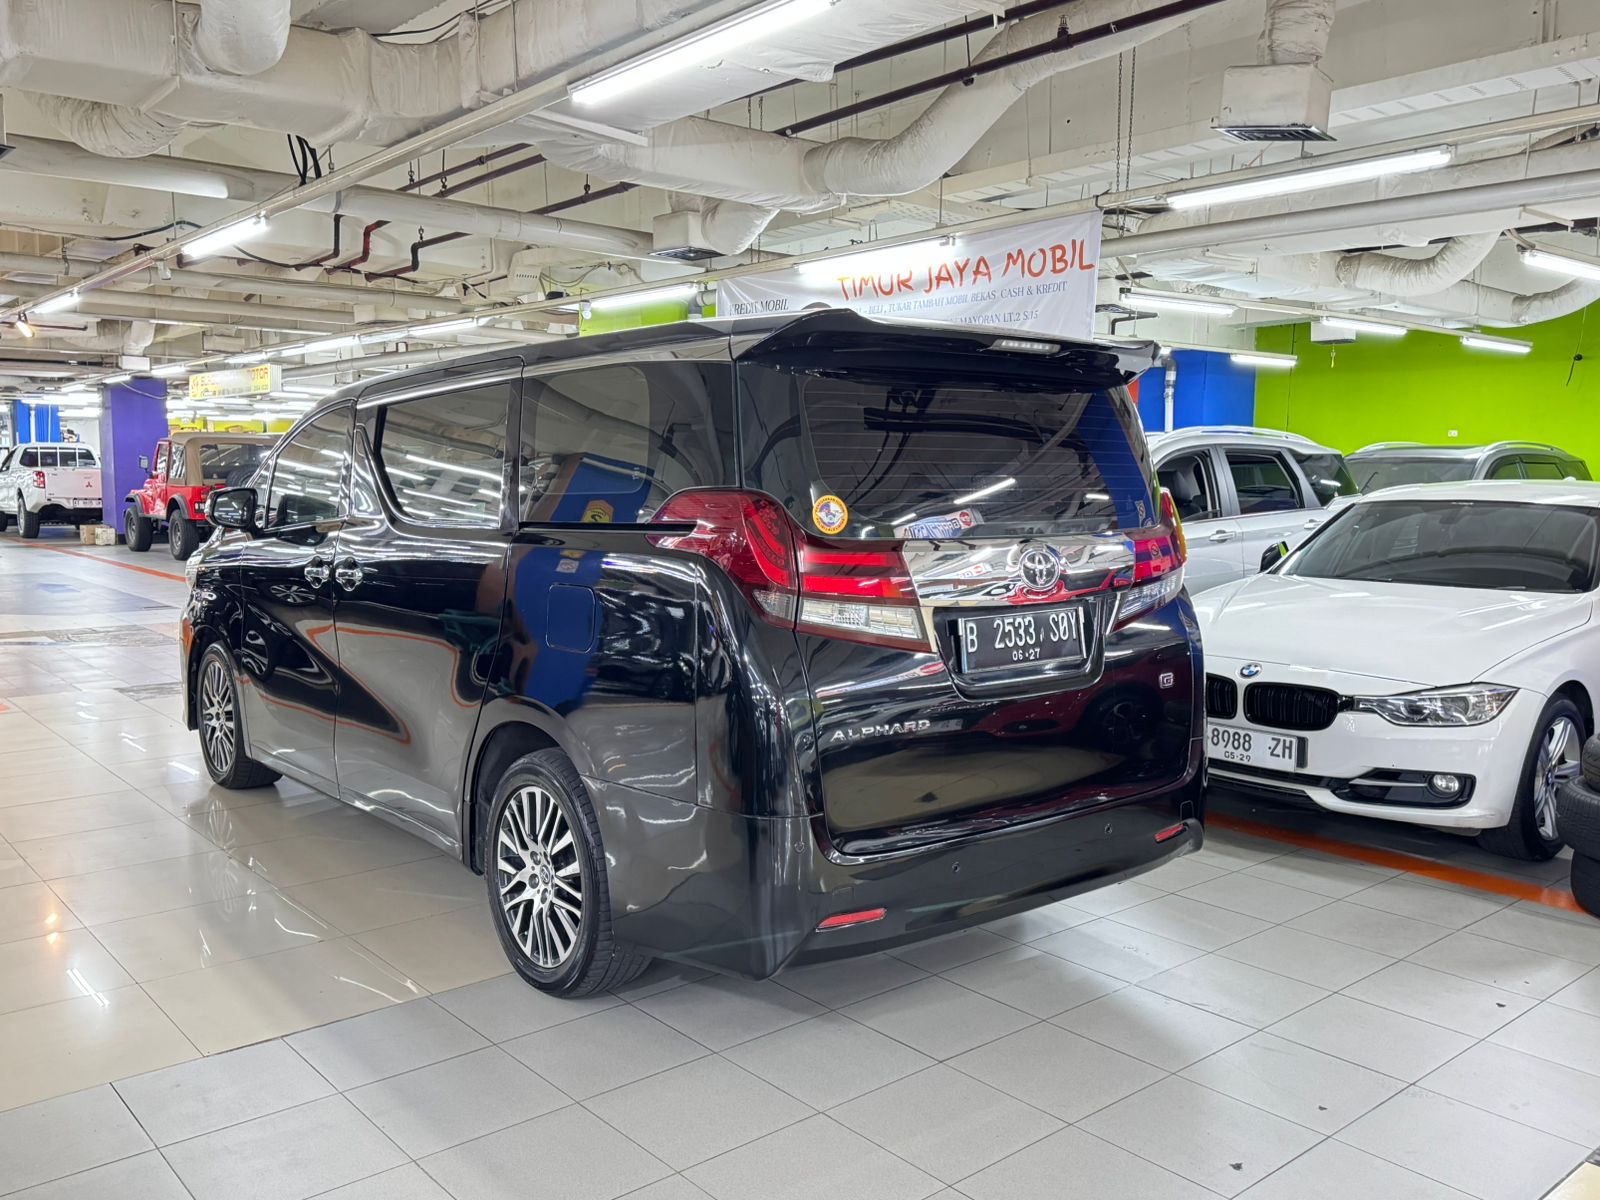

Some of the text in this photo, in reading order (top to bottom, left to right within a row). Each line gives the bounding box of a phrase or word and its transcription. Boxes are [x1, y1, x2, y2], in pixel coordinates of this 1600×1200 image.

[836, 238, 1095, 301] TIMUR JAYA MOBIL
[971, 289, 997, 302] BEKAS
[1000, 286, 1025, 299] CASH
[1027, 285, 1034, 296] &
[1036, 280, 1068, 295] KREDIT
[760, 298, 789, 312] MOBIL
[1003, 311, 1021, 323] LT.2
[966, 621, 978, 653] B
[993, 615, 1036, 649] 2533
[830, 719, 931, 743] ALPHARD
[1210, 727, 1294, 760] 8988 ZH
